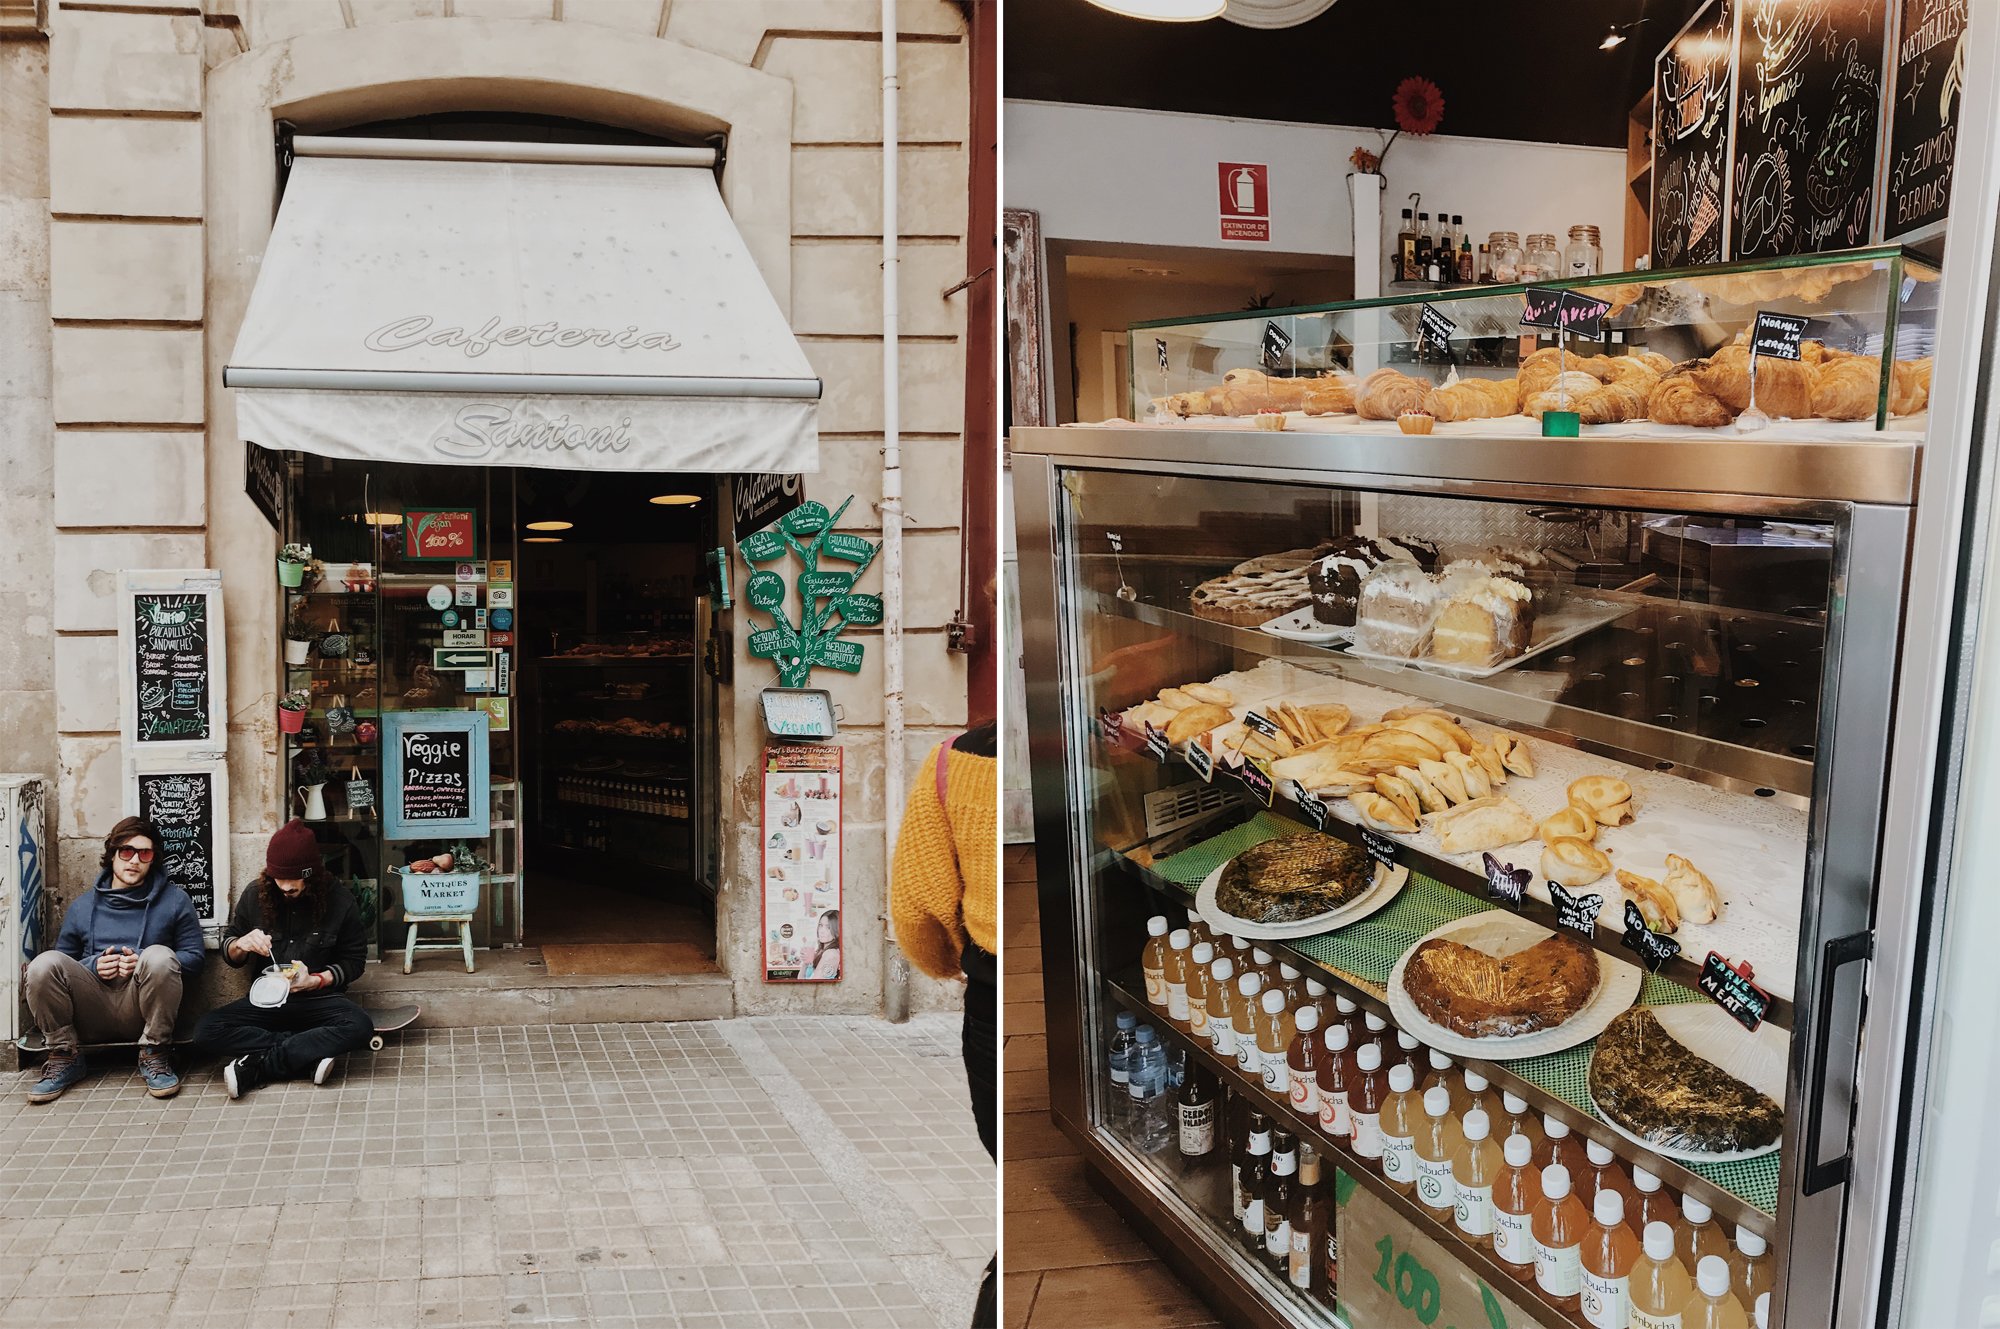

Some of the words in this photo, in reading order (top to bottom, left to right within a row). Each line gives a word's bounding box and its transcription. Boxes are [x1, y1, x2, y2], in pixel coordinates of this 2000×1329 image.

[1901, 6, 1960, 67] NATURALES
[1910, 125, 1954, 177] ZUMOS
[1898, 174, 1946, 224] BEBIDAS
[1222, 222, 1257, 230] EXTINTOR
[1257, 223, 1267, 231] DE
[1227, 230, 1264, 238] INCENDIOS
[1761, 318, 1800, 331] NORMAL
[364, 314, 682, 358] Cafeteria
[1757, 340, 1796, 353] CEREAL
[434, 403, 631, 458] Santoni
[828, 534, 869, 551] GUANABANA
[150, 625, 191, 638] BOCADILLOS
[752, 630, 780, 644] BEBIDAS
[149, 637, 193, 651] SANDWICHES
[753, 638, 792, 653] VEGETALES
[825, 641, 855, 654] BEBIDAS
[774, 720, 822, 734] VEGANO
[403, 733, 461, 765] Veggie
[408, 768, 463, 786] Pizzas
[420, 879, 468, 888] ANTIQUES
[420, 889, 465, 898] MARKET
[1709, 954, 1749, 992] CARNE
[1701, 975, 1744, 1014] MEAT
[1724, 981, 1764, 1022] VEGETAL
